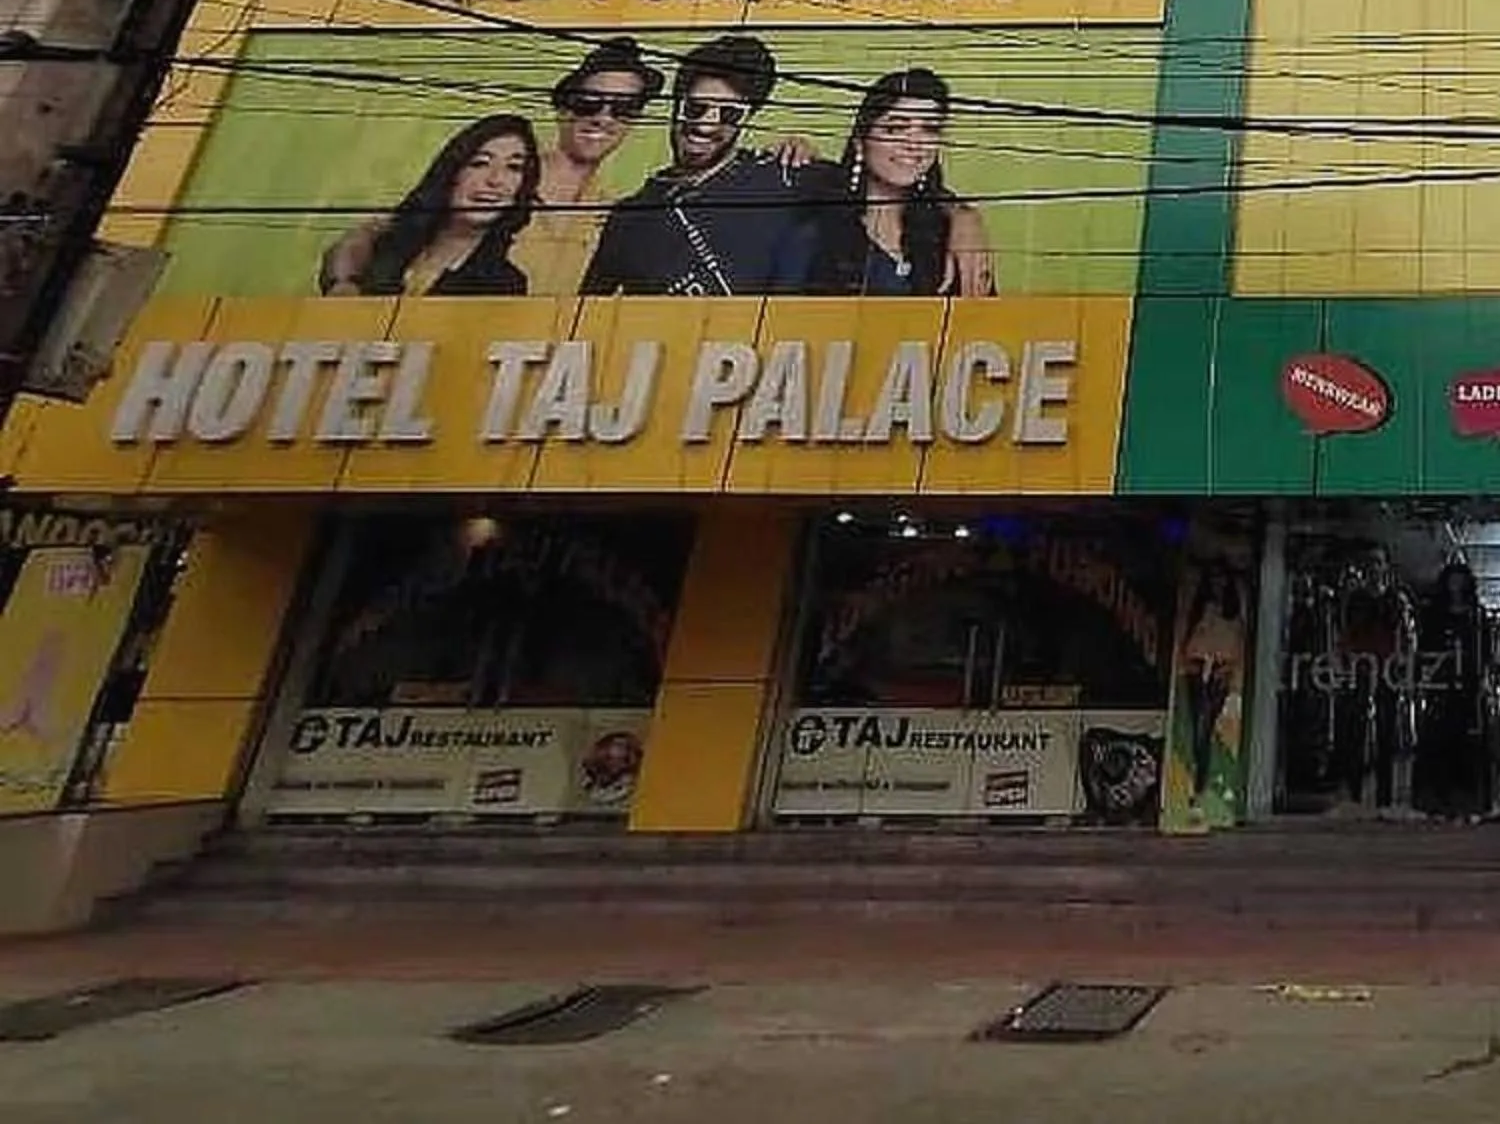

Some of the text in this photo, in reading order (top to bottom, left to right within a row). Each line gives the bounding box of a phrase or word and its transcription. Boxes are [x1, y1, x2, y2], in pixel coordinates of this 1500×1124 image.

[110, 340, 1078, 446] HOTEL TAJ PALACE
[333, 714, 410, 749] TAJ
[833, 715, 1053, 752] TAJ RESTAURANT
